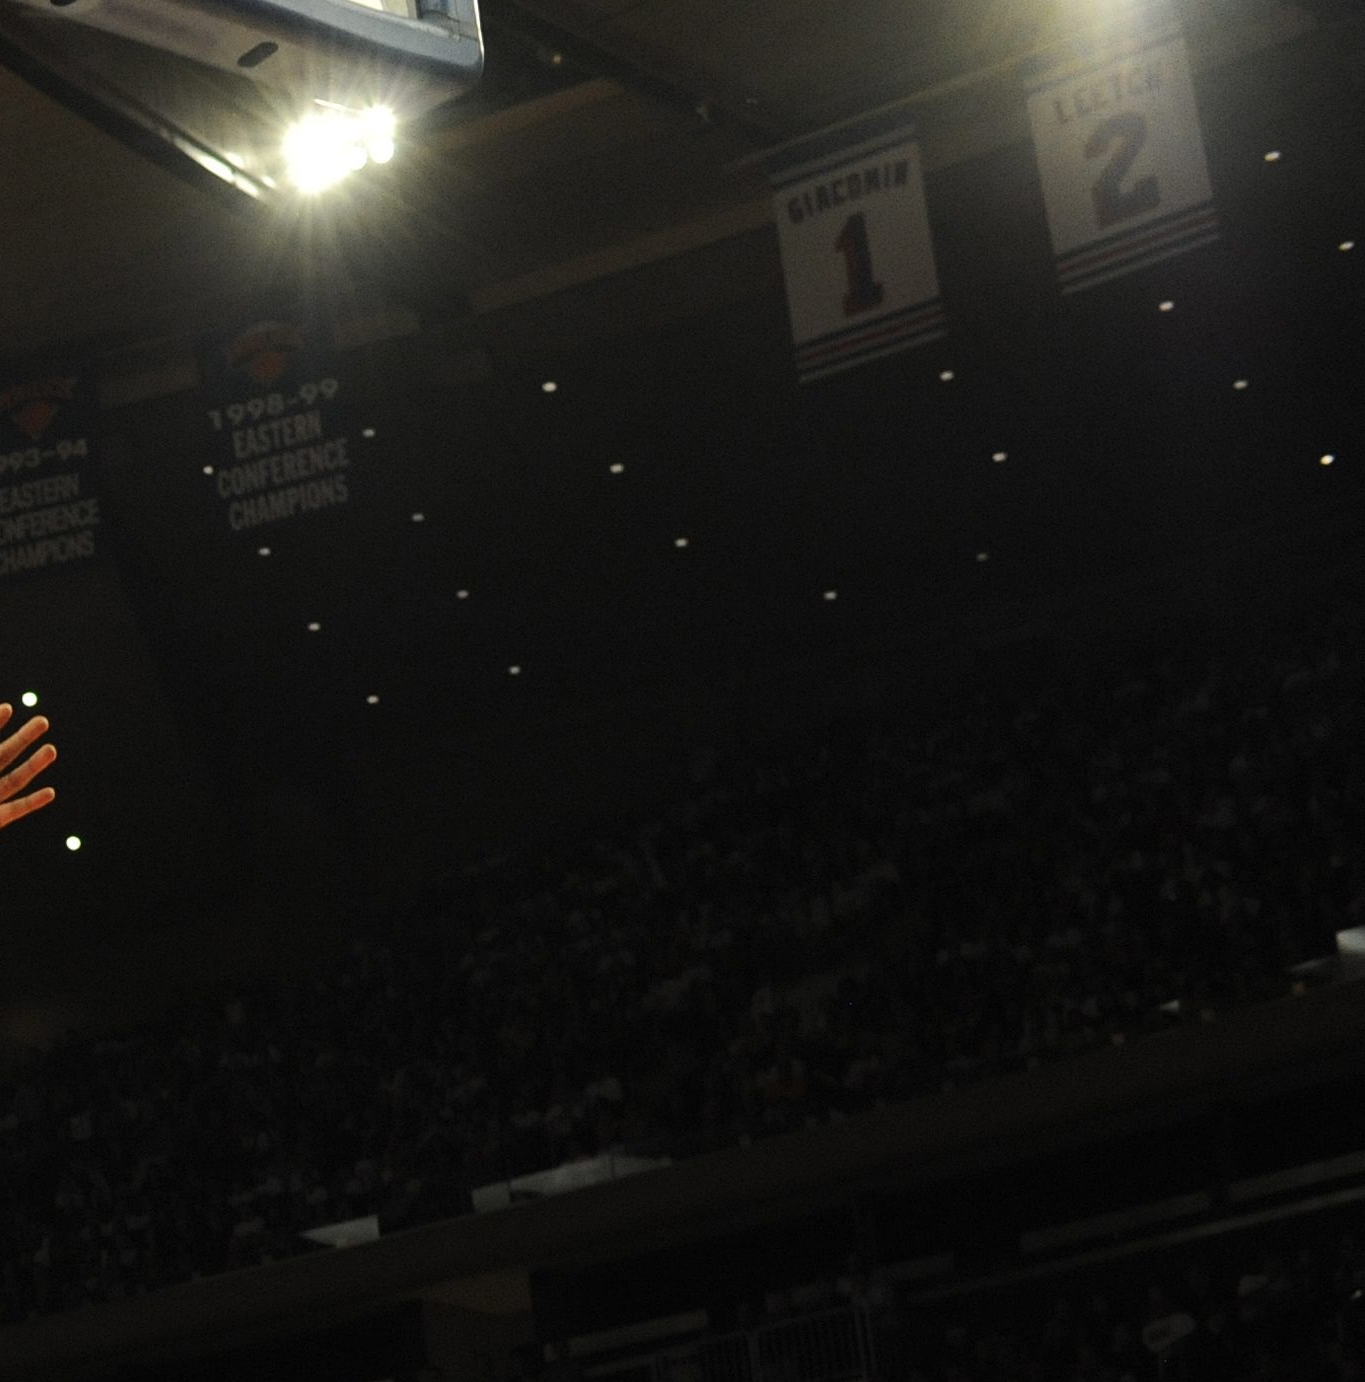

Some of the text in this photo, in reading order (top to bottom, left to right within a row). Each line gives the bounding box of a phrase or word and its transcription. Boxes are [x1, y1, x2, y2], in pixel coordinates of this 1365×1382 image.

[1084, 112, 1160, 229] 2
[834, 211, 884, 319] 1
[232, 410, 322, 459] EASTERN
[217, 437, 351, 499] CONFERENCE
[228, 474, 349, 531] CHAMPIONS
